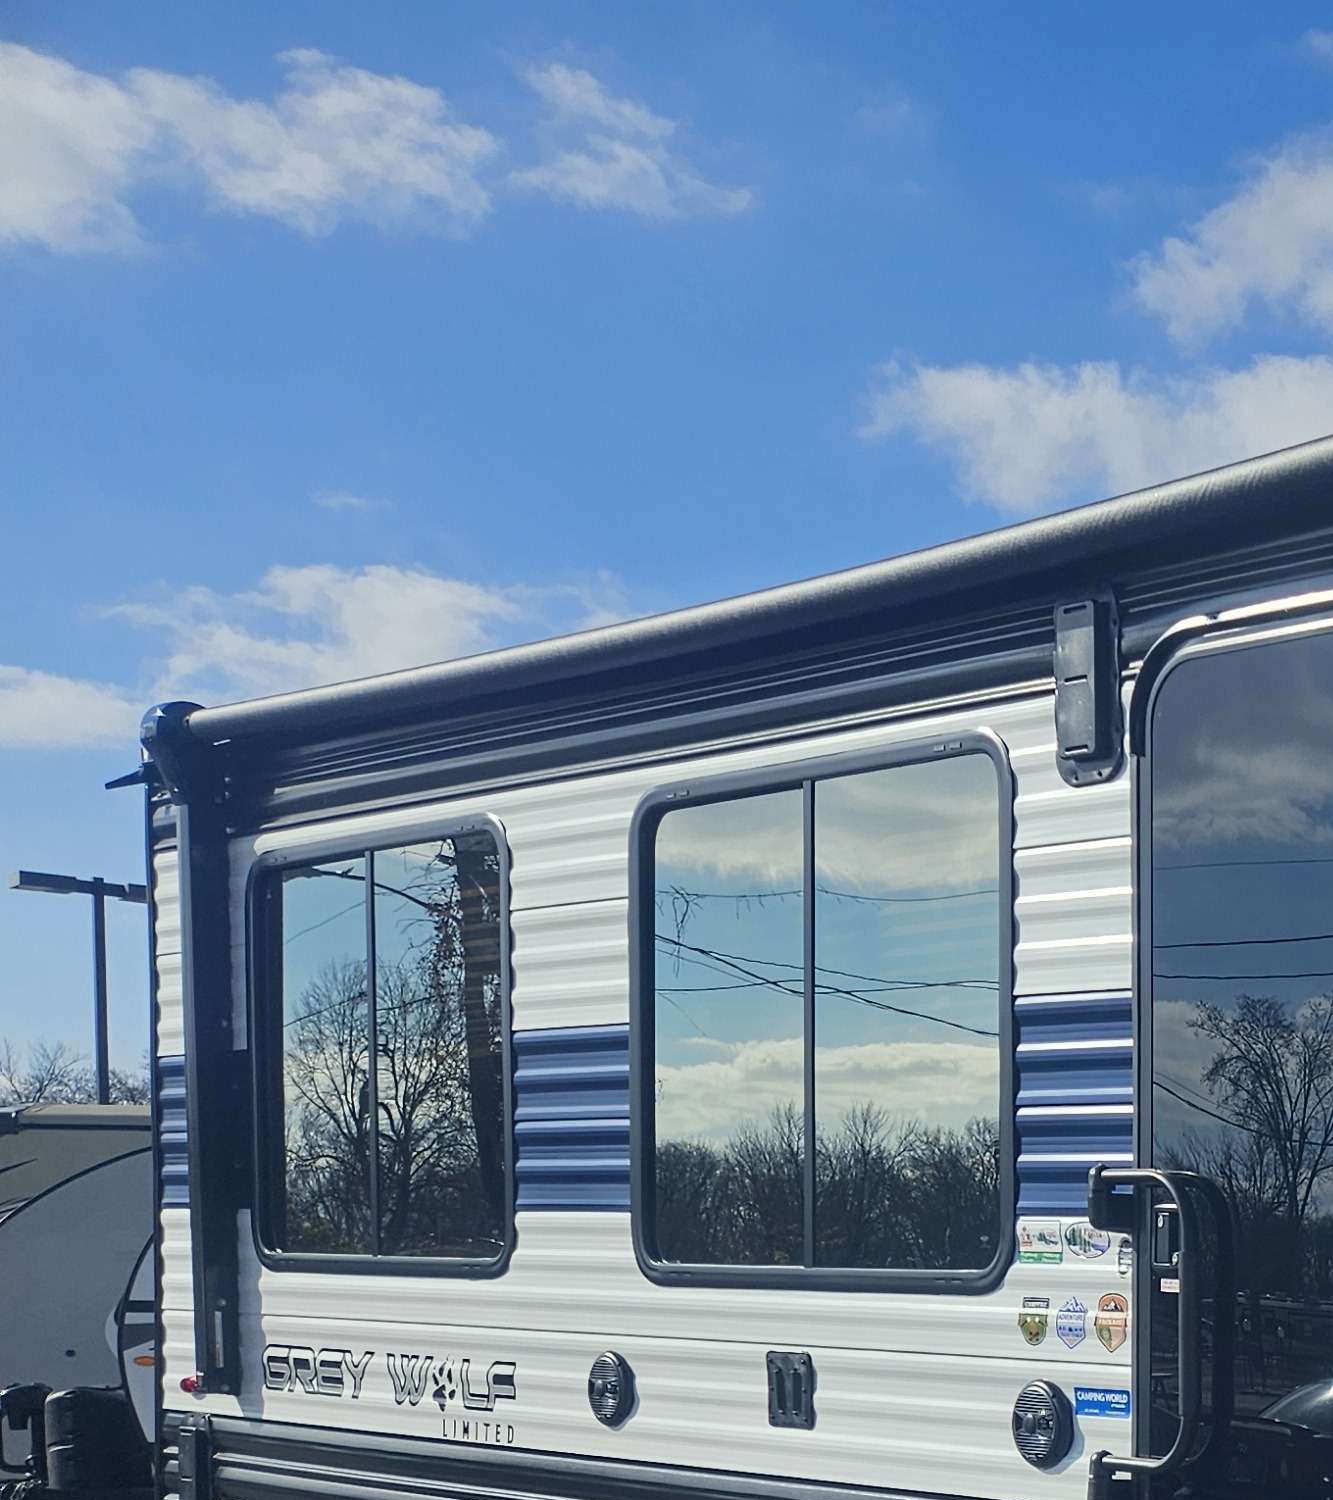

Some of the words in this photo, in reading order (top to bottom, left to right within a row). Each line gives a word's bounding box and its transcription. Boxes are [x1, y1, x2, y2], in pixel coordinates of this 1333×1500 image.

[262, 1343, 375, 1399] GREY
[1076, 1391, 1105, 1402] CAMPING
[1105, 1393, 1128, 1404] WORLD
[442, 1418, 515, 1444] LIMITED
